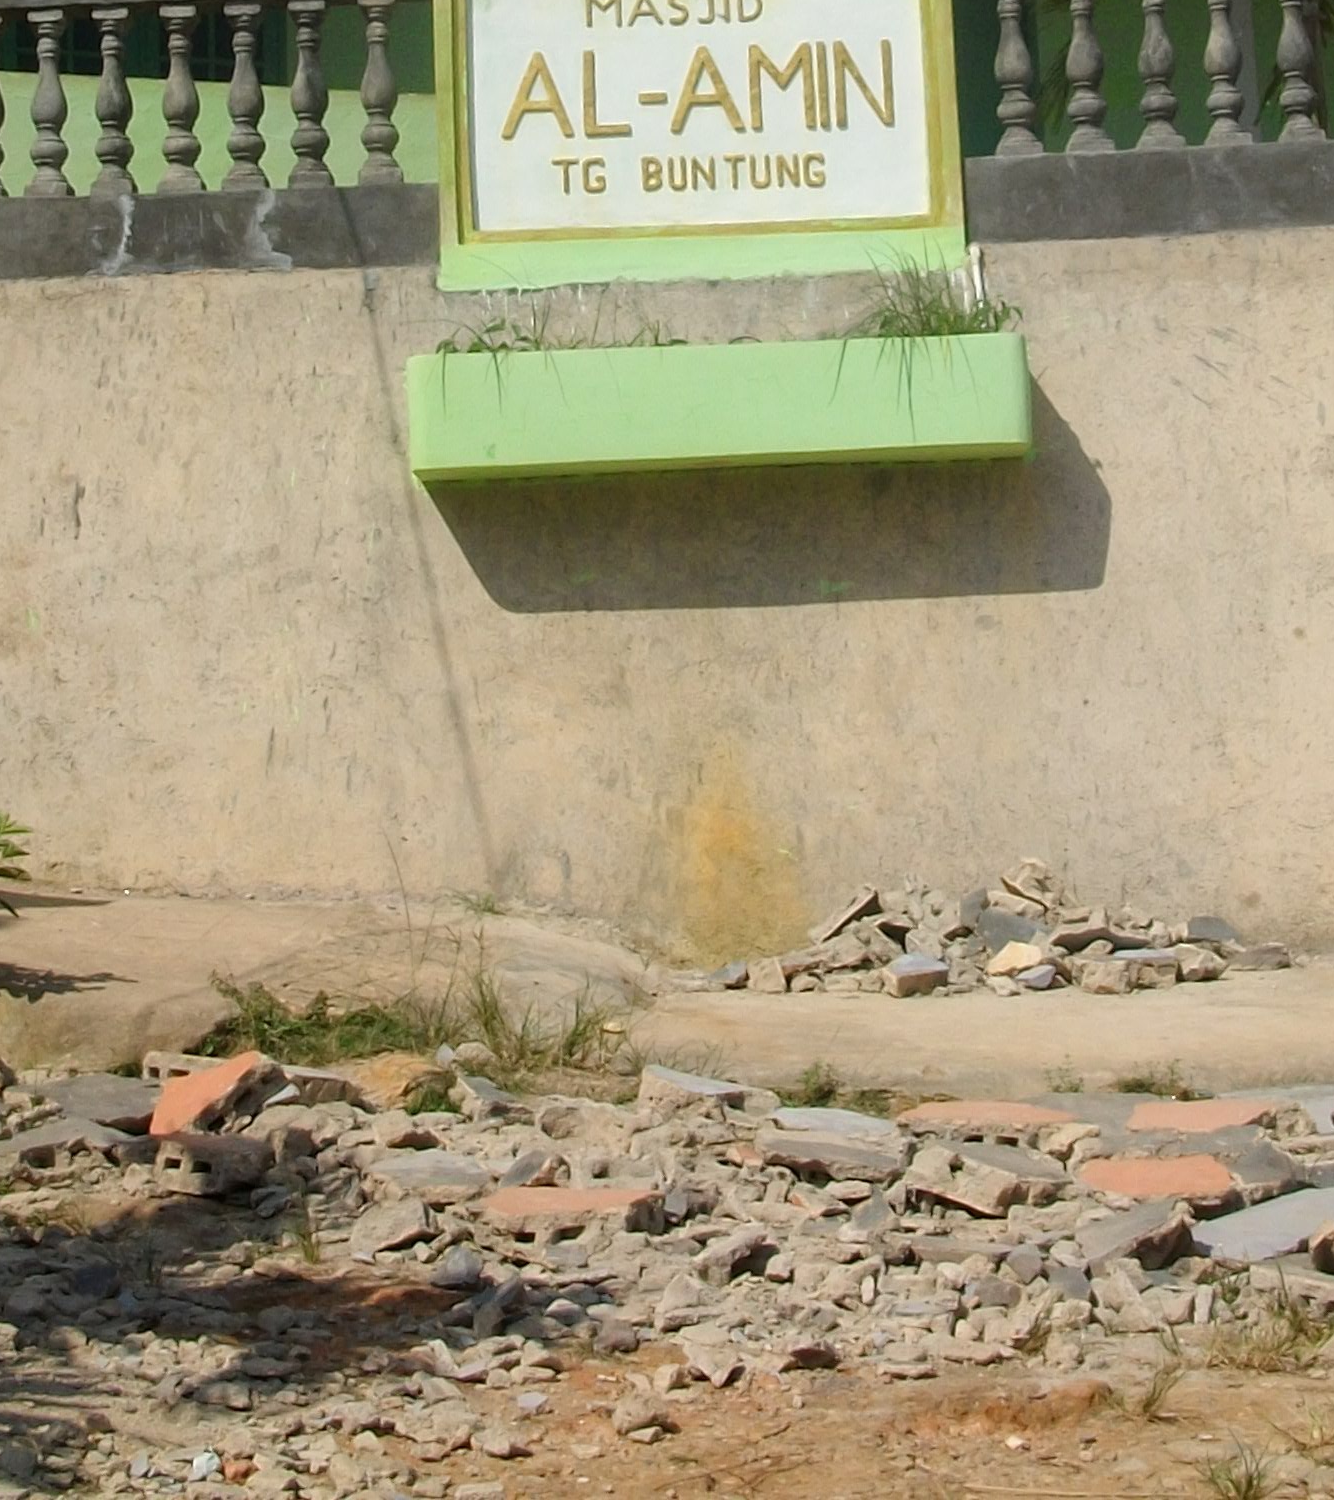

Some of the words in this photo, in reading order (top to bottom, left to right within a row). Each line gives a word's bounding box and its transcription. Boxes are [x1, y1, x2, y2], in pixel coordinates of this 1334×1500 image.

[501, 38, 895, 140] AL-AMIN
[551, 156, 607, 194] TG
[641, 152, 827, 193] BUNTUNG
